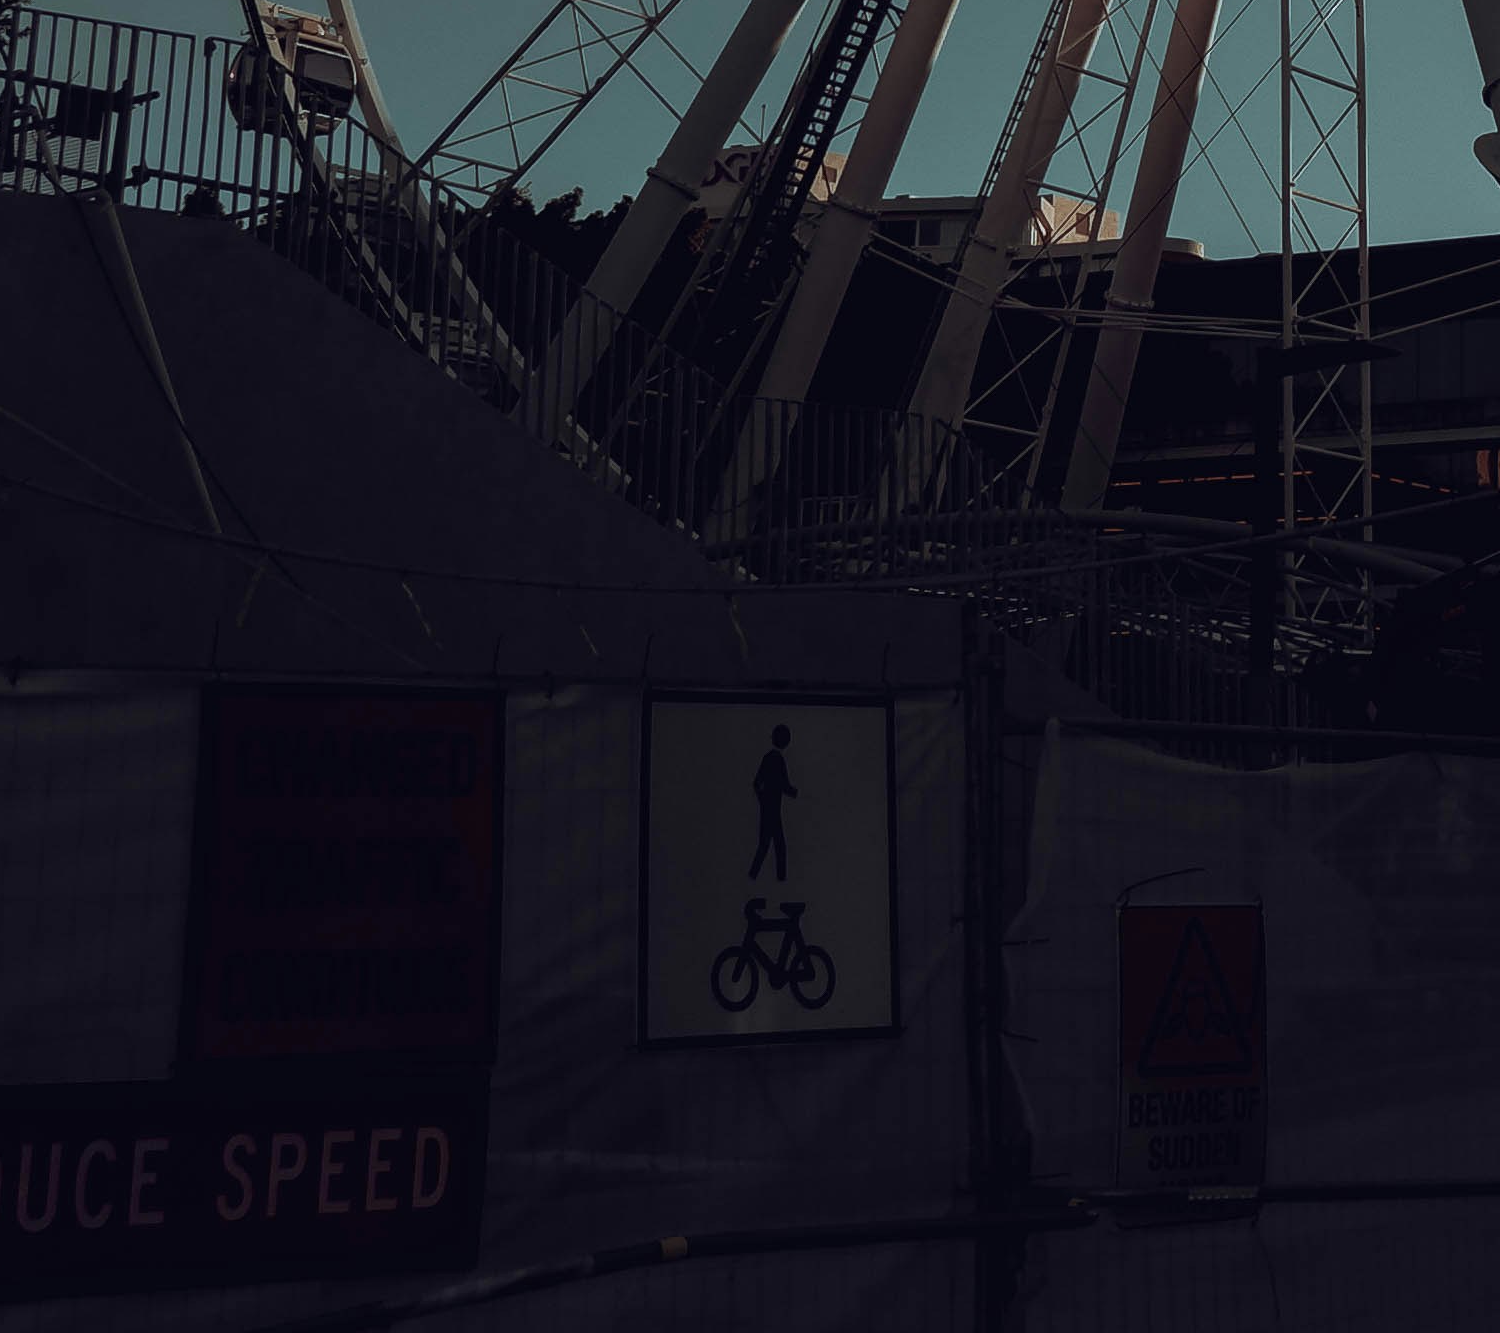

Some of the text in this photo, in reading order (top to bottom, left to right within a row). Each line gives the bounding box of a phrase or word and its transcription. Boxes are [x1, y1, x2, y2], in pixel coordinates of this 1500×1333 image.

[1128, 1086, 1261, 1128] BEWARE OF
[1147, 1131, 1241, 1171] SUDDEN
[215, 1124, 452, 1223] SPEED
